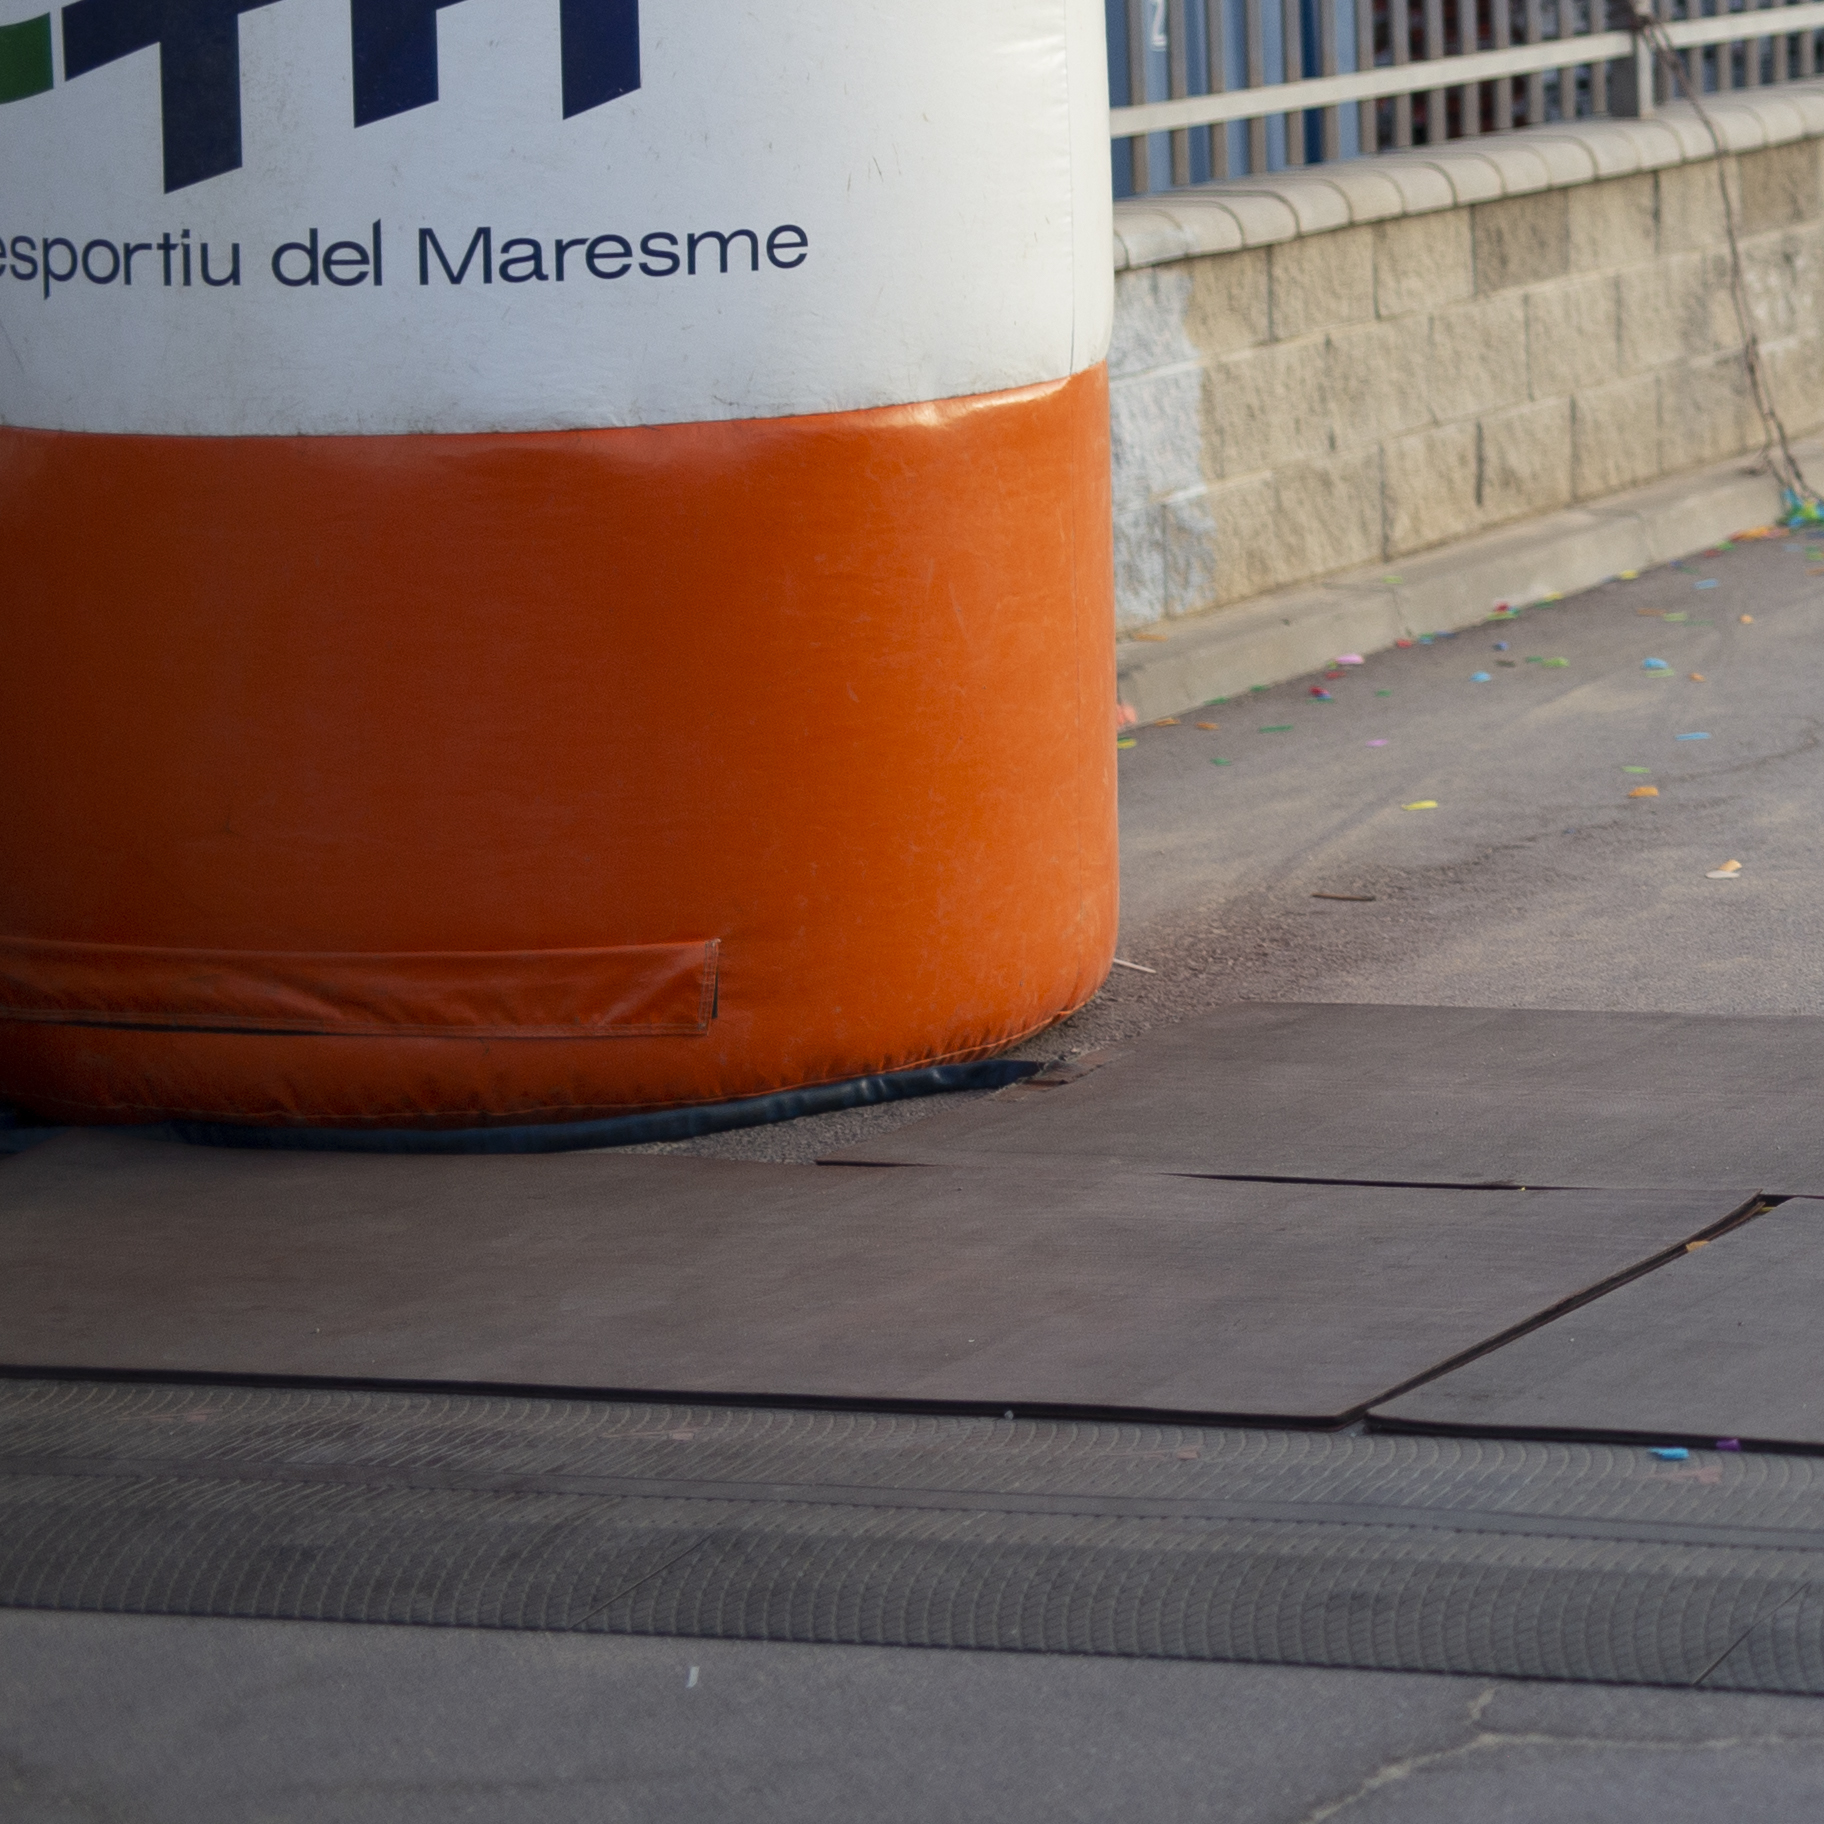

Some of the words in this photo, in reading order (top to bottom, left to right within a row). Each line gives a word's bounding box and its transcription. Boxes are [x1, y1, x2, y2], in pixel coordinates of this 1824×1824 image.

[0, 229, 241, 301] sportiu
[271, 218, 382, 287] del
[418, 224, 808, 286] Maresme
